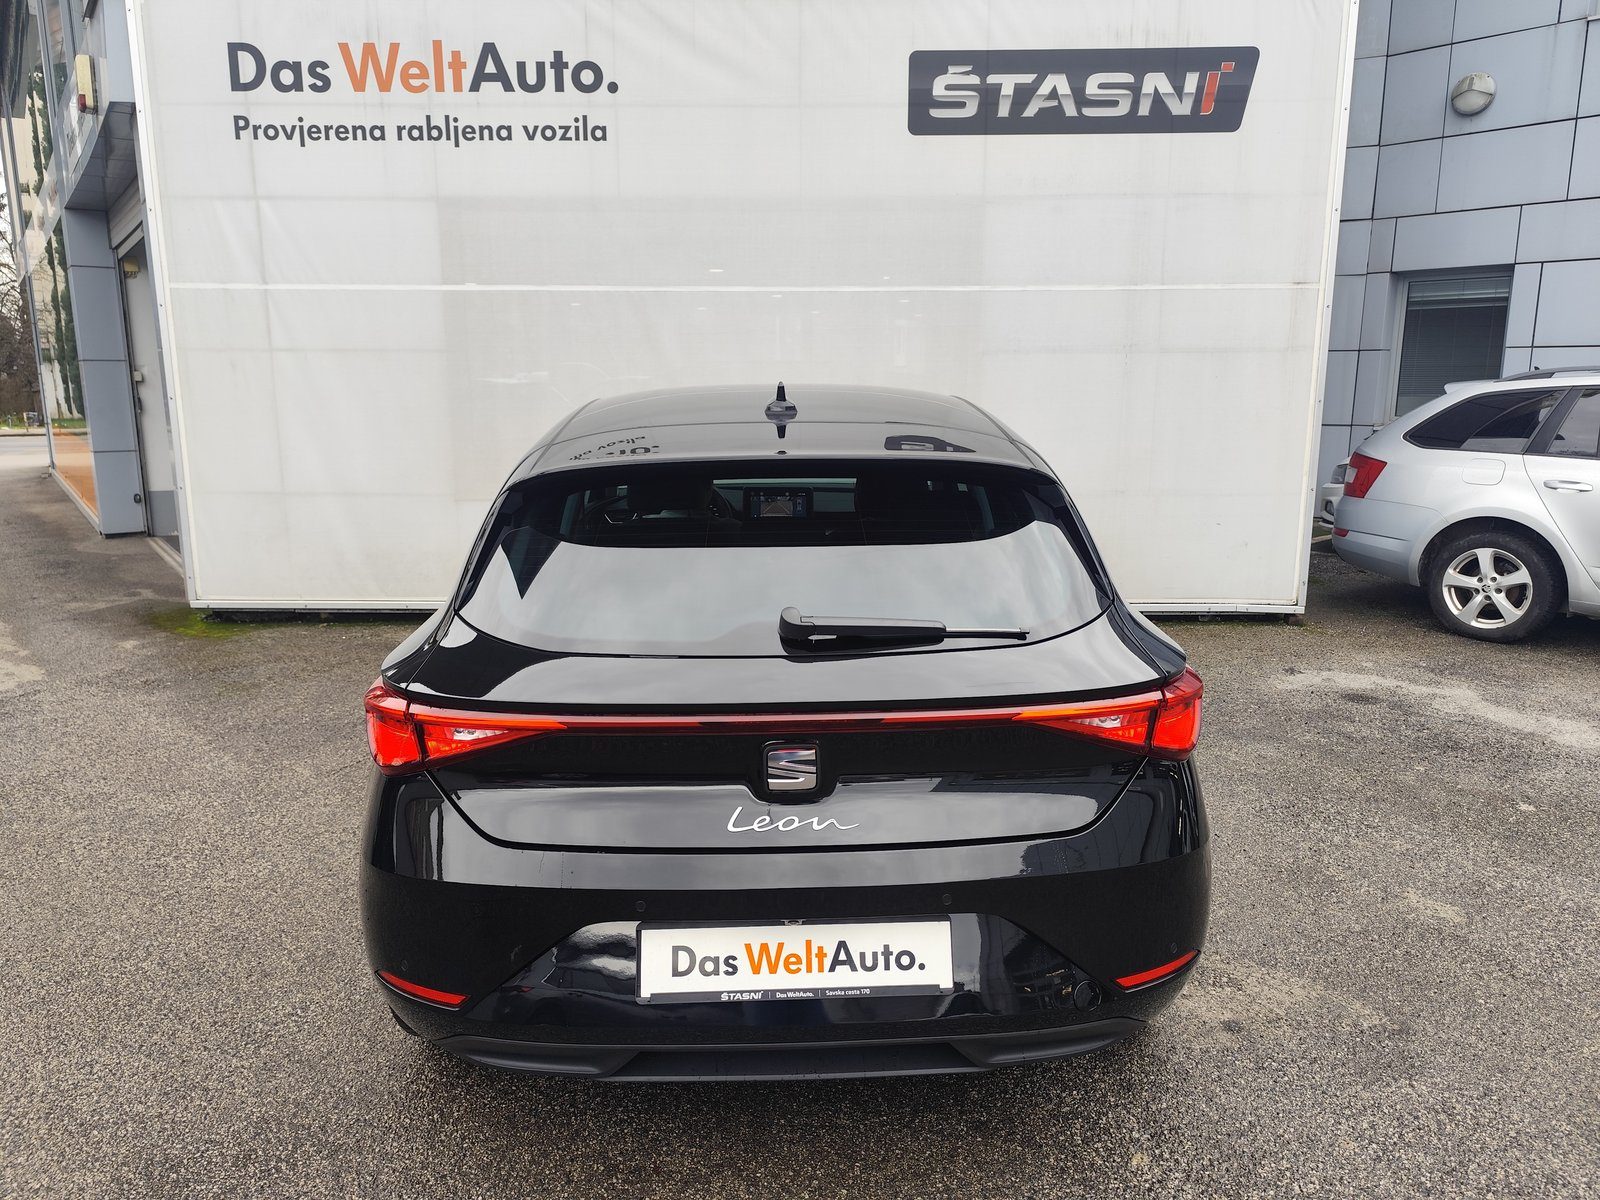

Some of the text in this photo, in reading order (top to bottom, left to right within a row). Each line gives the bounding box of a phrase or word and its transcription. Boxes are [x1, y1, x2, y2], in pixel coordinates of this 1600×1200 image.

[227, 39, 619, 94] Das WeltAuto.
[233, 114, 607, 148] Provjerena rabljena vozila
[726, 806, 860, 833] Leon
[671, 939, 926, 978] Das WeltAuto.
[860, 987, 871, 995] 170
